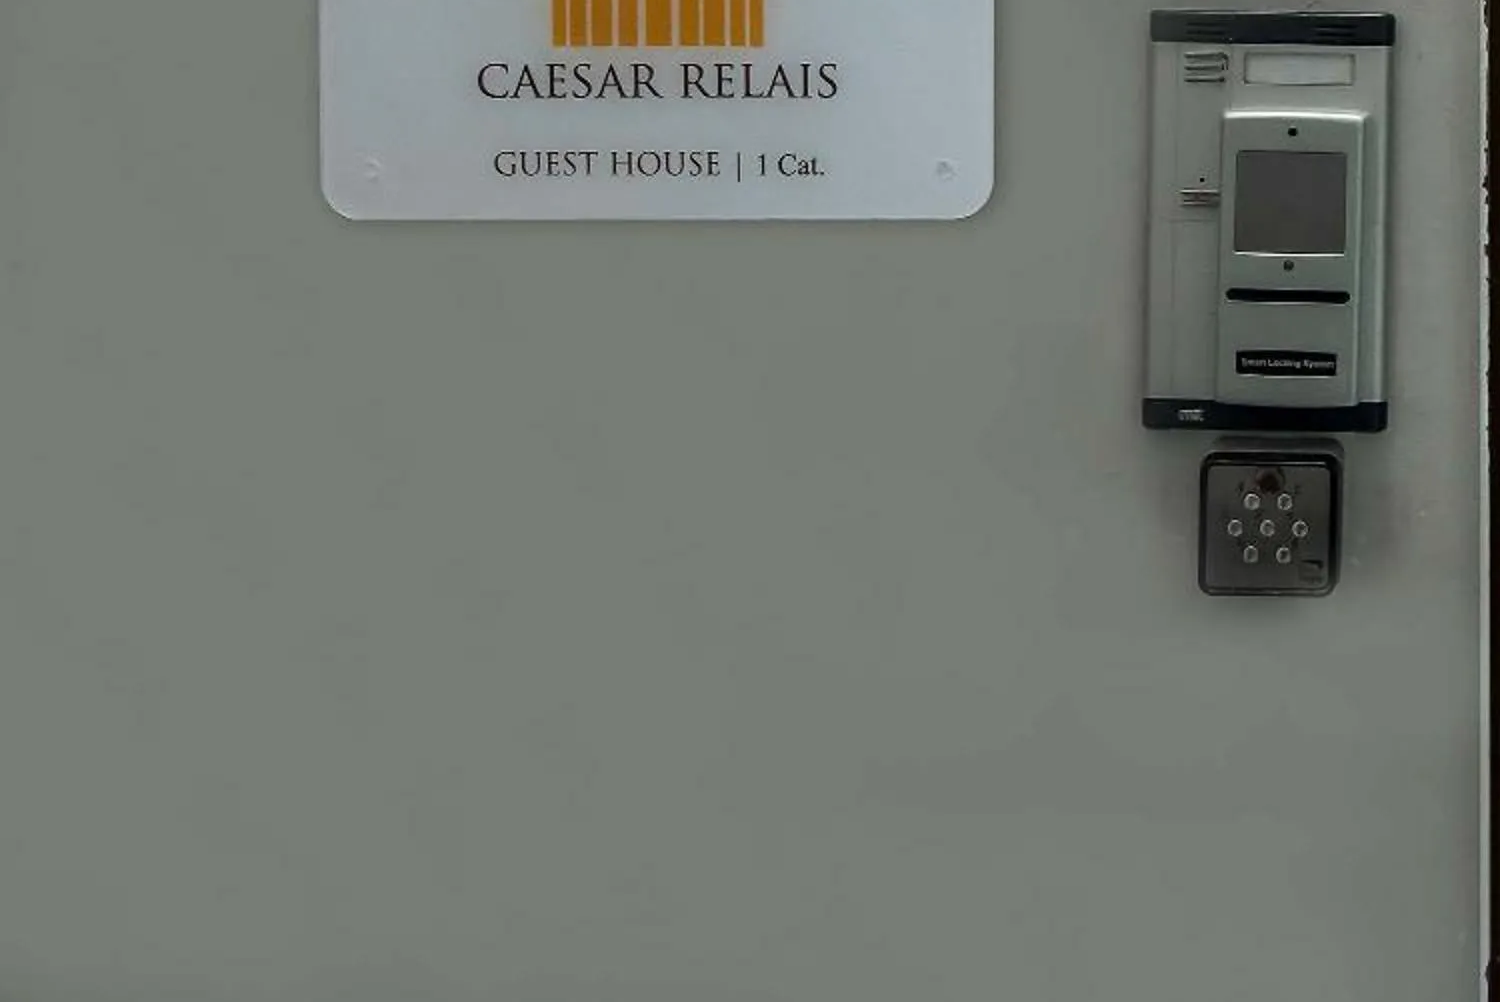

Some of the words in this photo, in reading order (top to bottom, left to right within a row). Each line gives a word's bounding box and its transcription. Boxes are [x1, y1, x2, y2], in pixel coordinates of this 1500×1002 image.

[478, 63, 664, 99] CAESAR
[680, 64, 838, 99] RELAIS
[494, 152, 598, 177] GUEST
[611, 152, 720, 177] HOUSE
[757, 153, 767, 177] 1
[778, 153, 825, 177] Cat.
